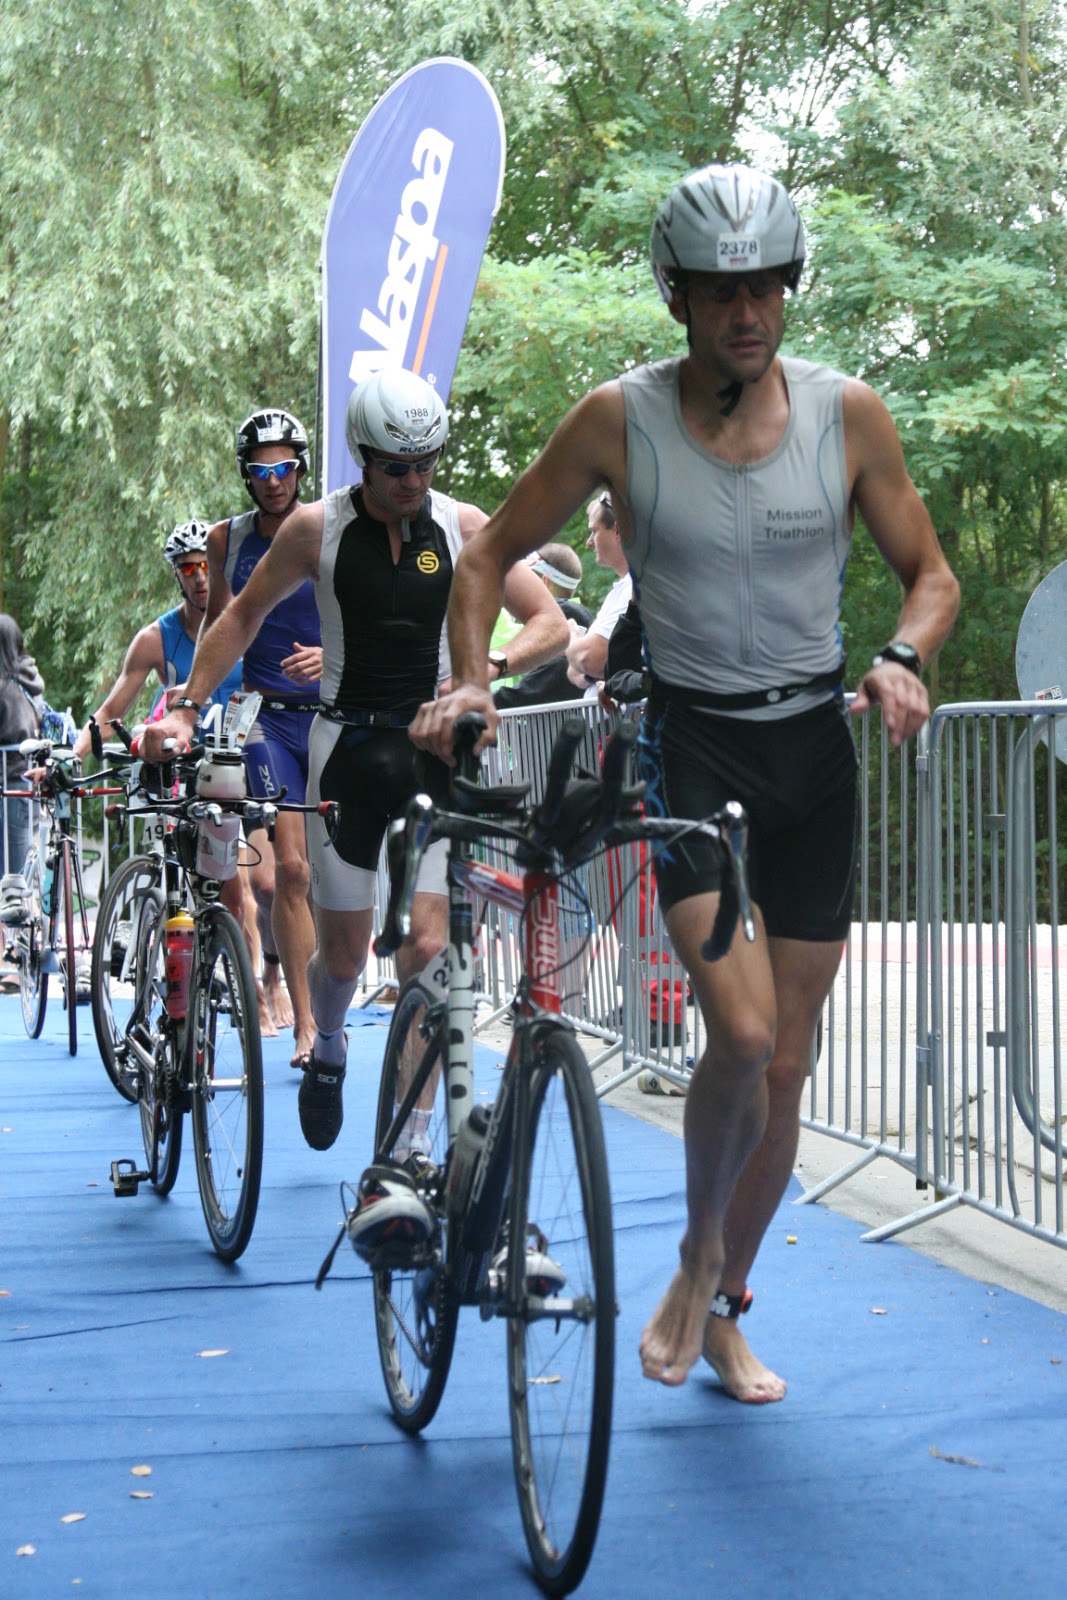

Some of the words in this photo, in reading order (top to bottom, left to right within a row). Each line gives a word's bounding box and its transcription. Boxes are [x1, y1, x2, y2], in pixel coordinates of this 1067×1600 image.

[719, 241, 758, 255] 2378
[404, 407, 429, 418] 1988
[399, 443, 433, 454] RUDY
[767, 508, 822, 521] Mission
[764, 526, 824, 540] Triathlon
